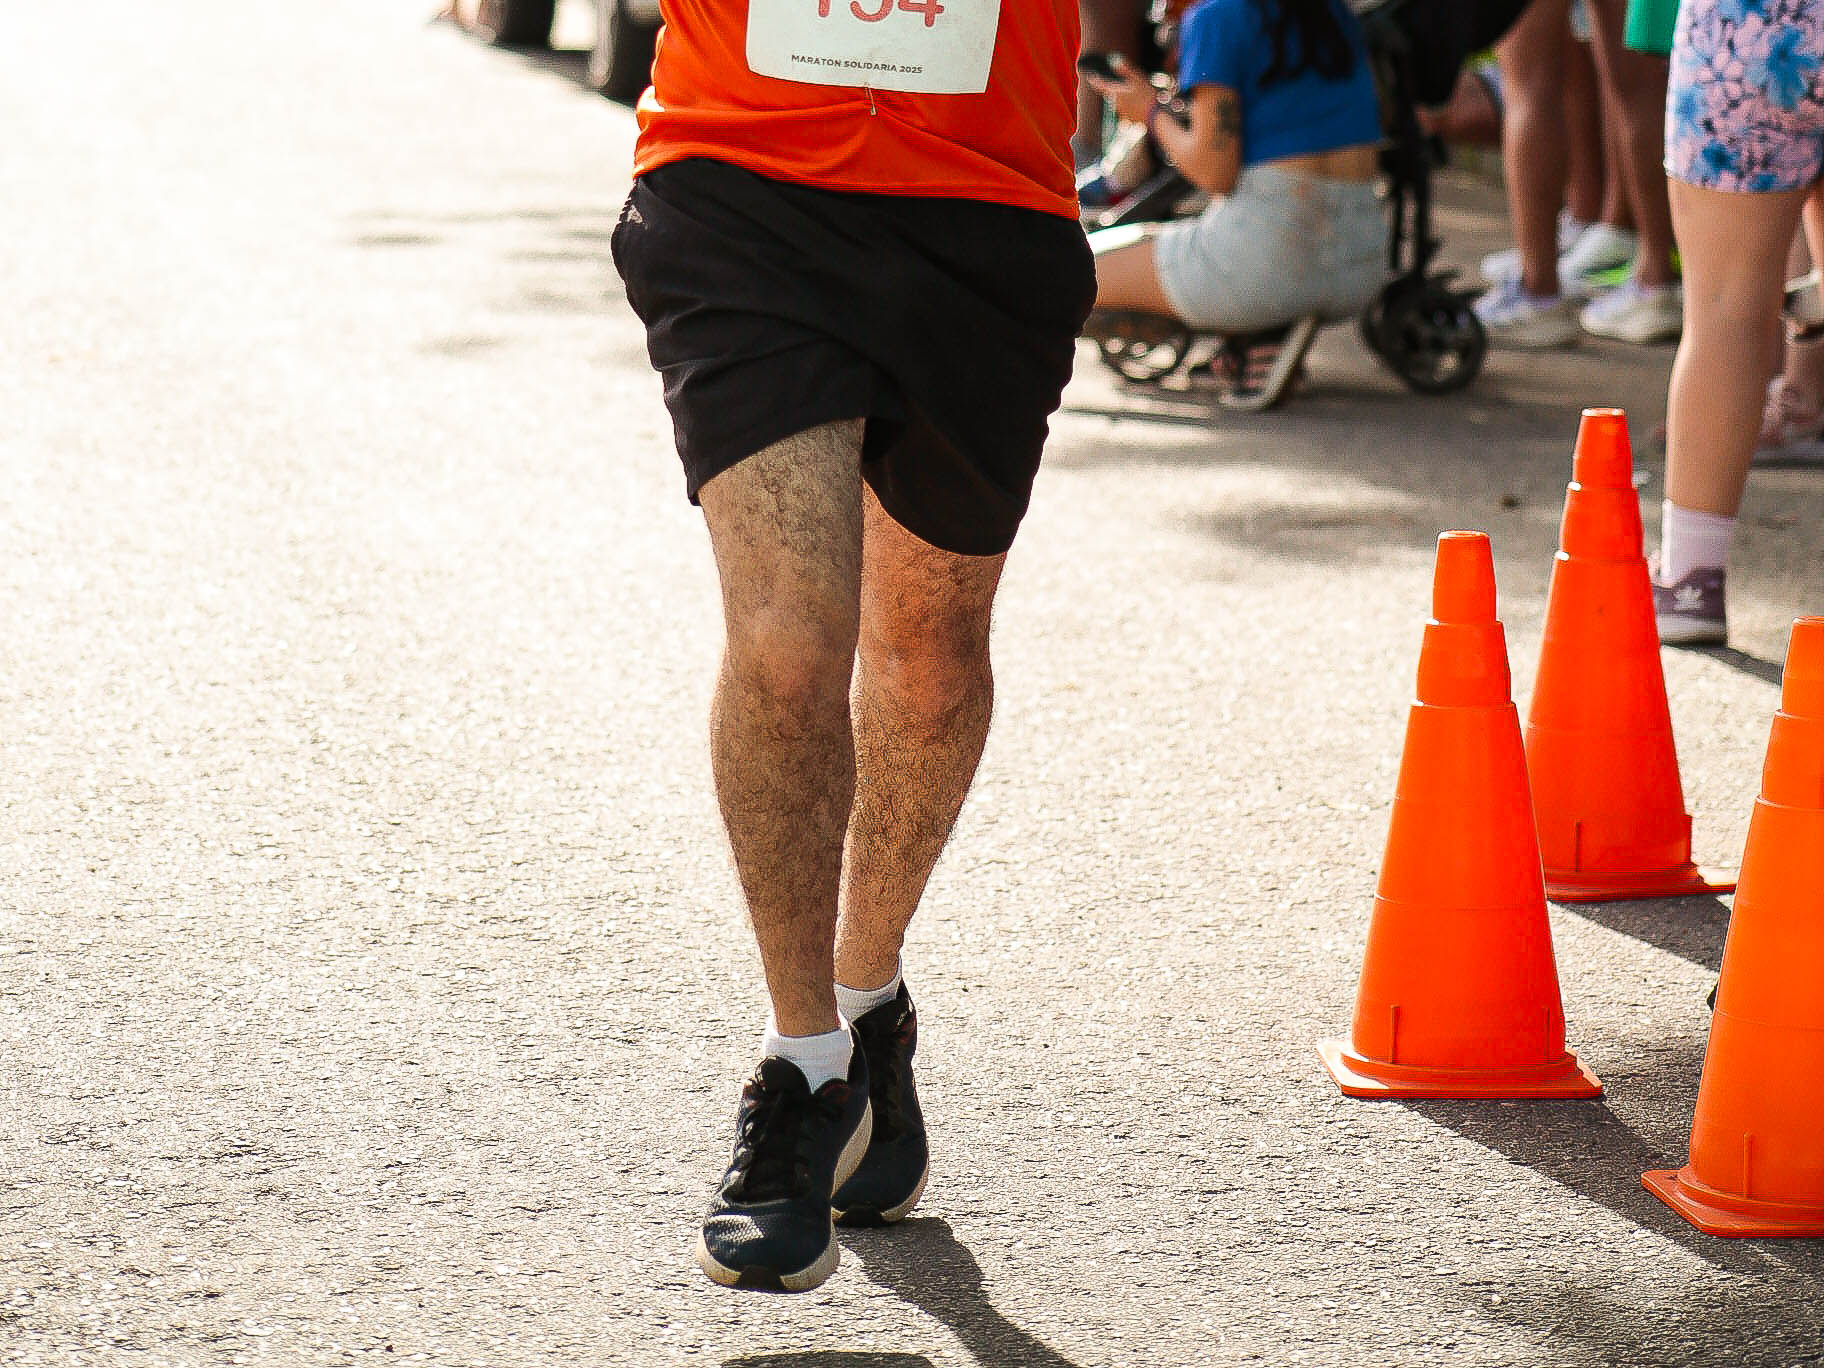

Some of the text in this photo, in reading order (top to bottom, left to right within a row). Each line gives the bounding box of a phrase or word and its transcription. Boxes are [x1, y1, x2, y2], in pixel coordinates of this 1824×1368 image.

[791, 54, 923, 74] MARATON SOLIDARIA 2025
